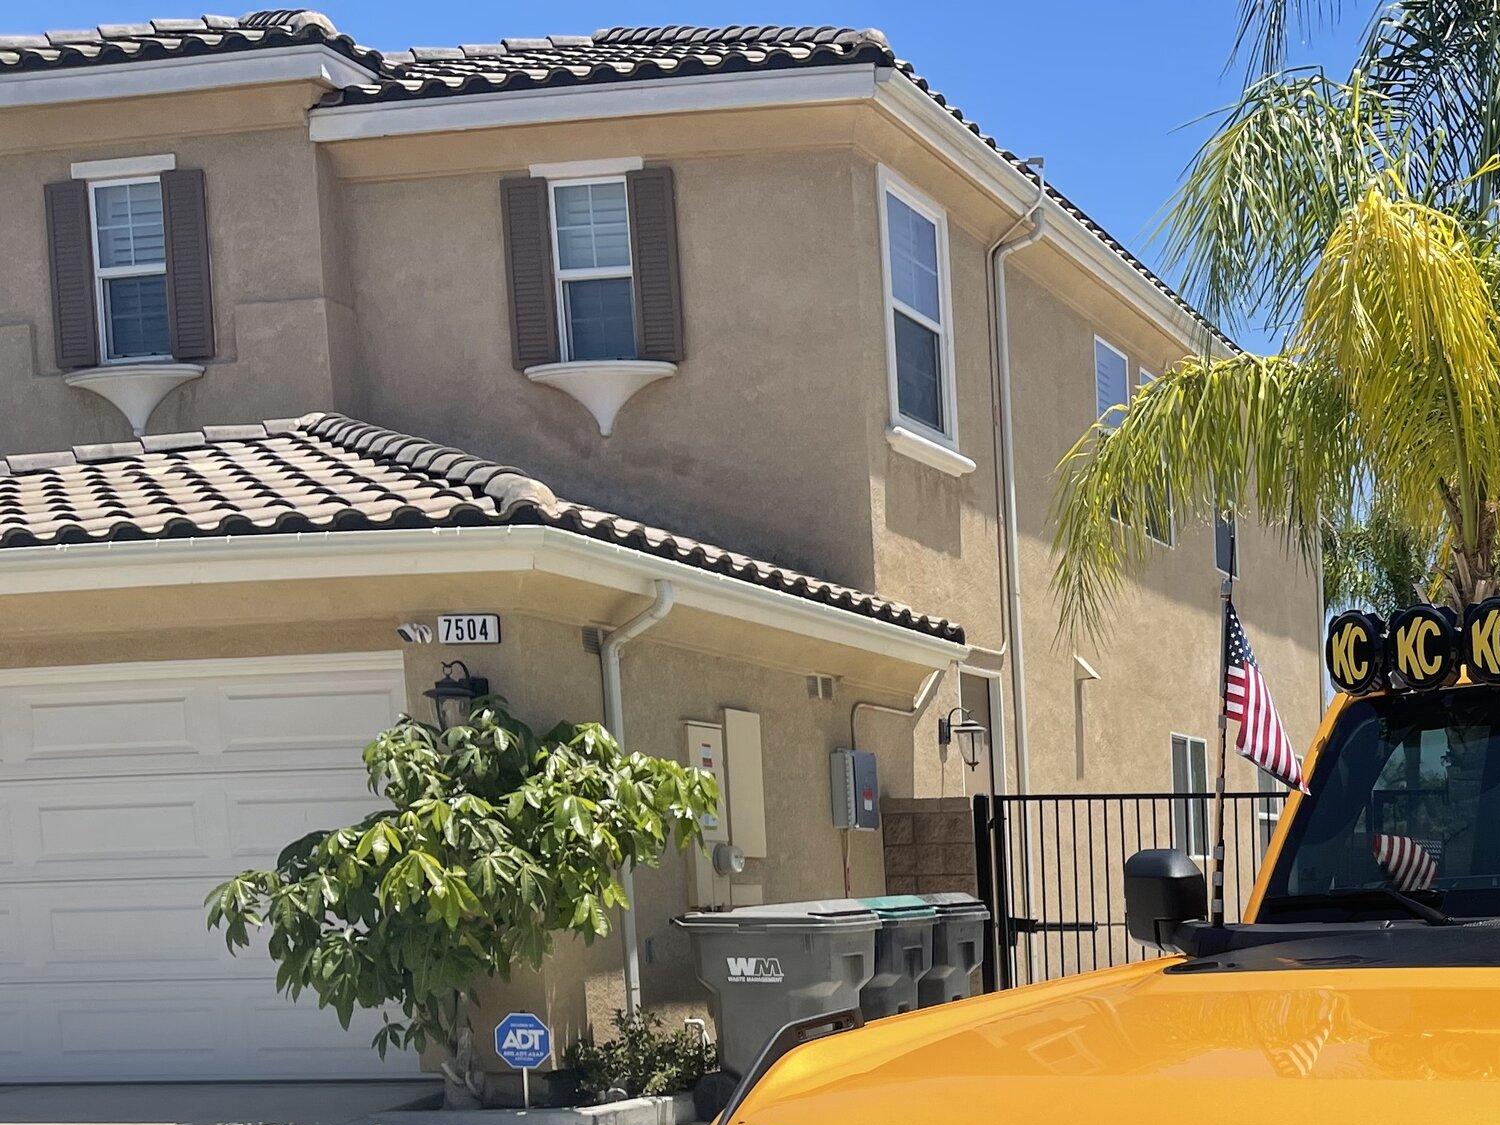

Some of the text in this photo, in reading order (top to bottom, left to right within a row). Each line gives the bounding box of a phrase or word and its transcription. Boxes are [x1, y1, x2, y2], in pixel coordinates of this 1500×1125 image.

[443, 618, 489, 641] 7504
[1332, 624, 1368, 684] KC
[1397, 617, 1442, 679] KC
[726, 957, 784, 976] WM
[502, 1029, 544, 1050] ADT
